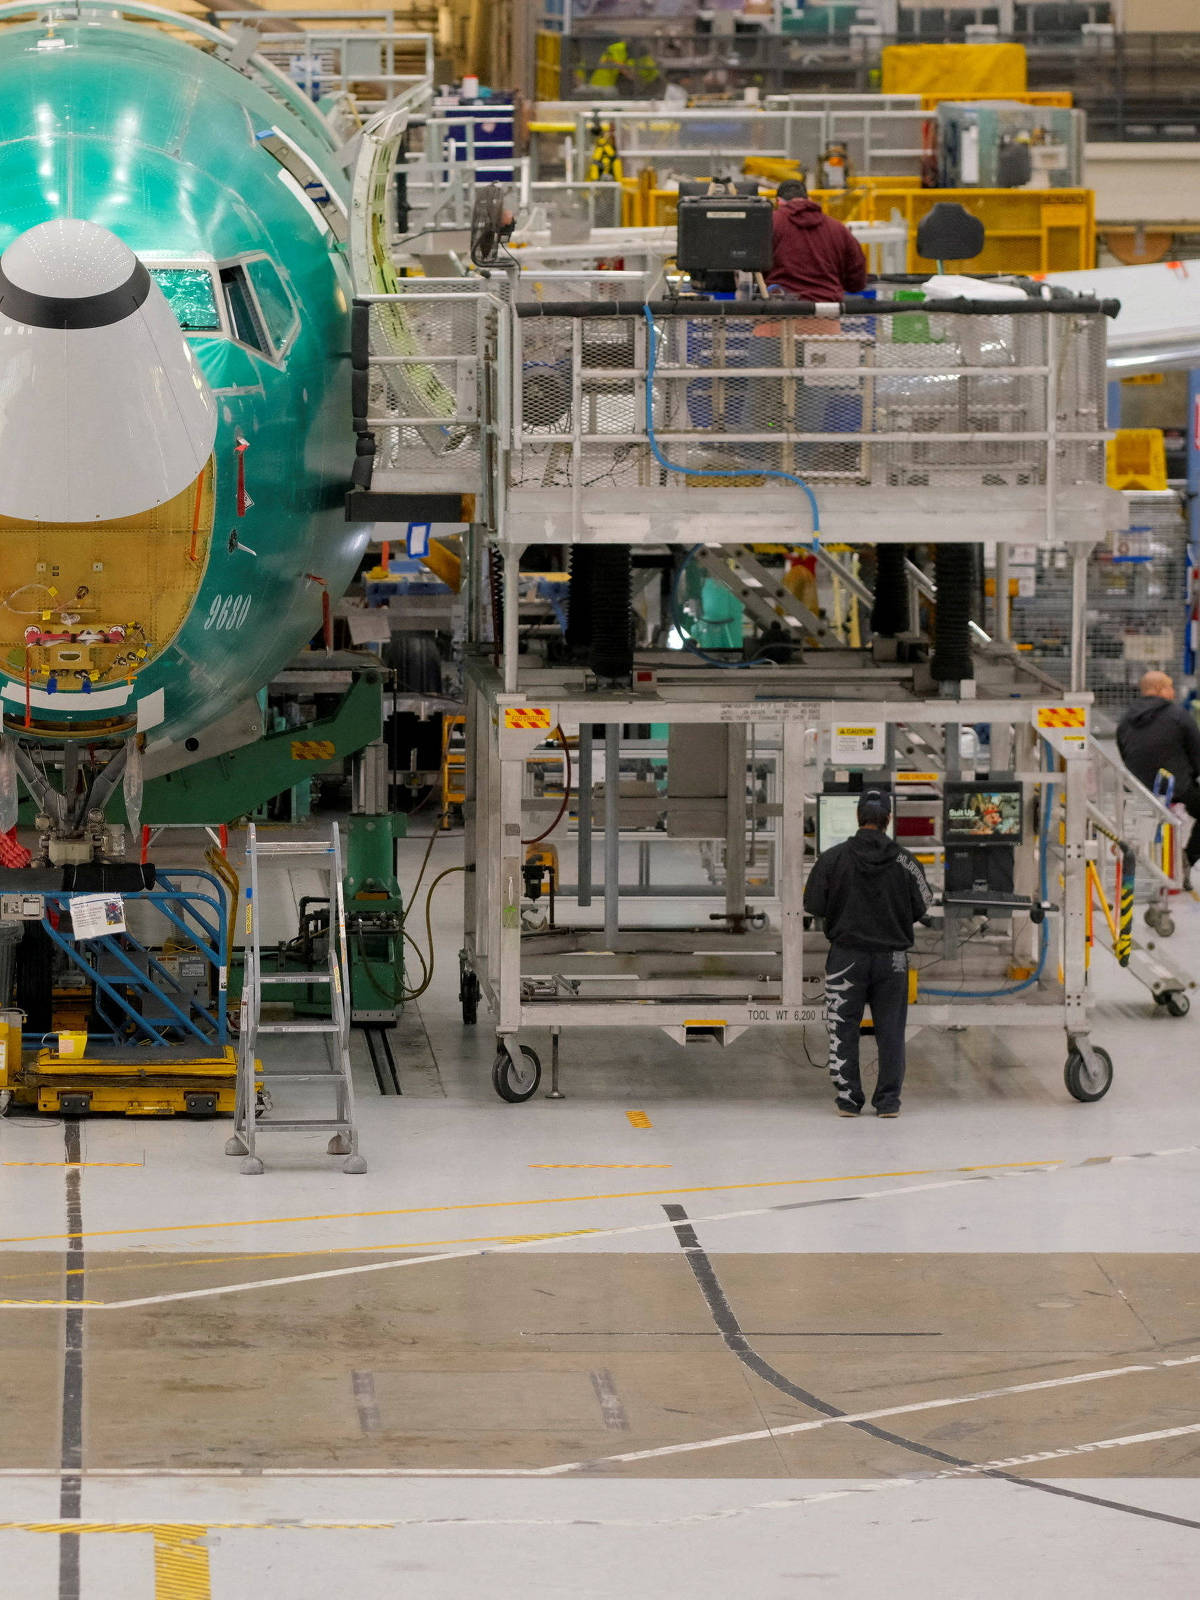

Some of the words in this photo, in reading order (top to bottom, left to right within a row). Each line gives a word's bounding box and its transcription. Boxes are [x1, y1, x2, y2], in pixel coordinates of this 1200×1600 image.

[204, 593, 252, 631] 9680
[964, 808, 976, 818] Up
[748, 1010, 769, 1020] TOOL
[776, 1010, 788, 1020] WT
[794, 1010, 816, 1022] 6,200
